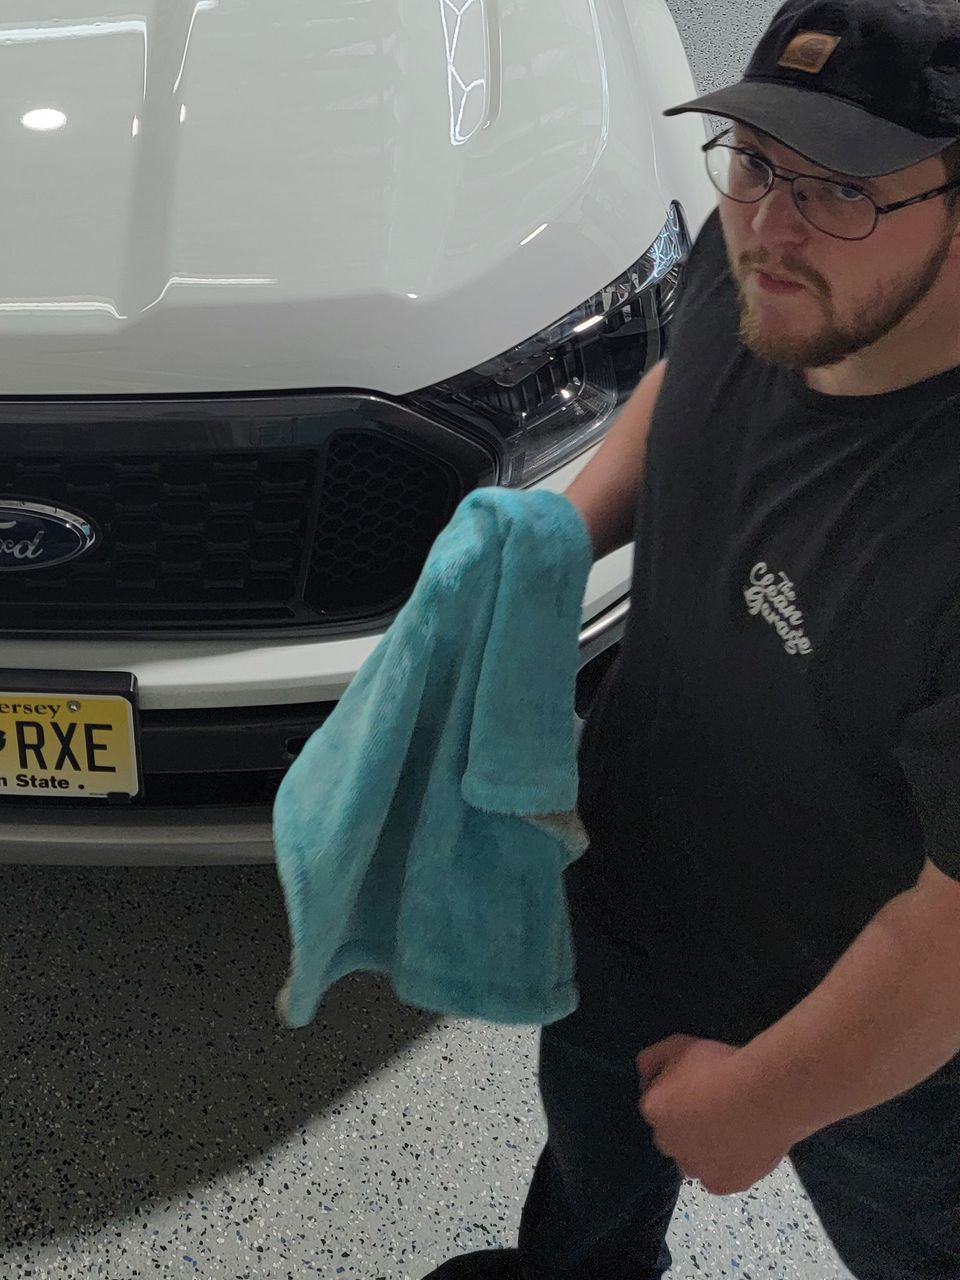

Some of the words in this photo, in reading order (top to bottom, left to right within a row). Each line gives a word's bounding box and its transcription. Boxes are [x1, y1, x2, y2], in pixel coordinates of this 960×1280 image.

[749, 561, 804, 626] Clean
[778, 571, 797, 601] The
[743, 585, 814, 655] Garage
[14, 720, 117, 773] RXE
[16, 773, 70, 790] State
